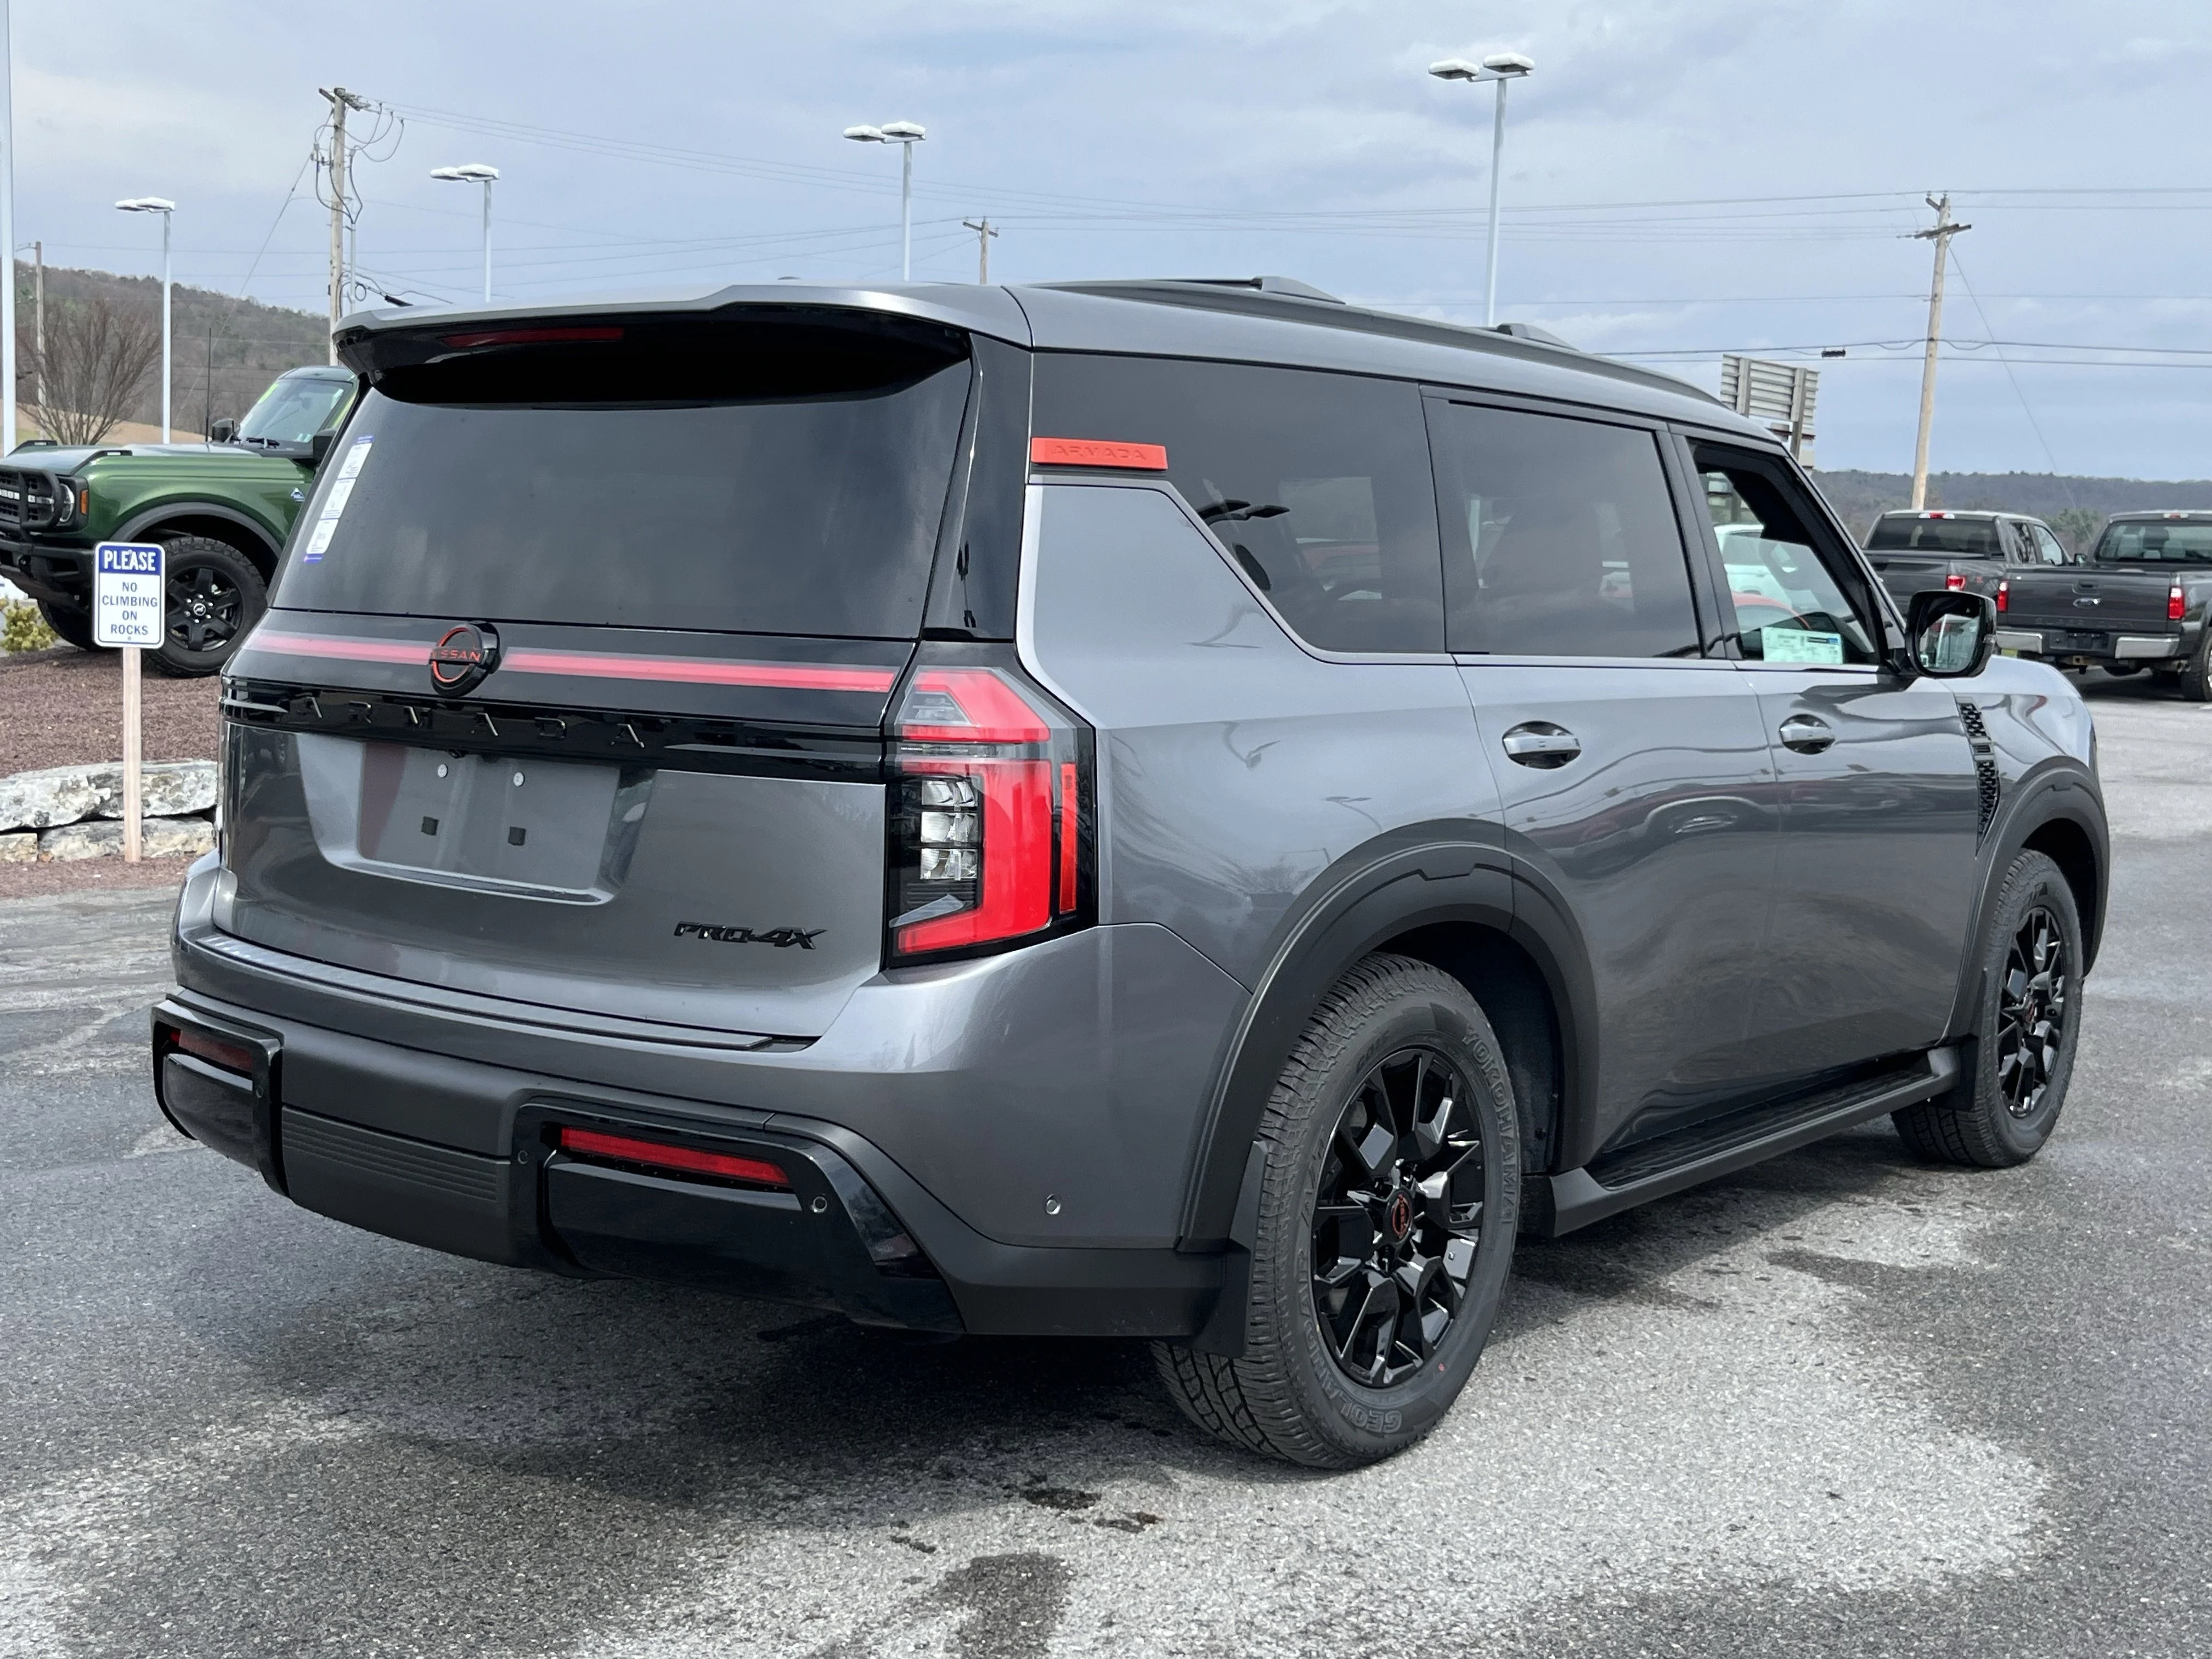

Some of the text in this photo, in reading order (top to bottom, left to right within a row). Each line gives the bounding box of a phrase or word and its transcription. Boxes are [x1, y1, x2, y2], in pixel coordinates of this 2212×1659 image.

[104, 549, 156, 571] PLEASE
[122, 582, 138, 592] NO
[102, 595, 158, 607] CLIMBING
[122, 610, 138, 621] ON
[111, 624, 149, 636] ROCKS
[432, 648, 481, 661] SSAN
[674, 921, 828, 950] PRO-4X
[1462, 1024, 1517, 1224] YOKOHAMA
